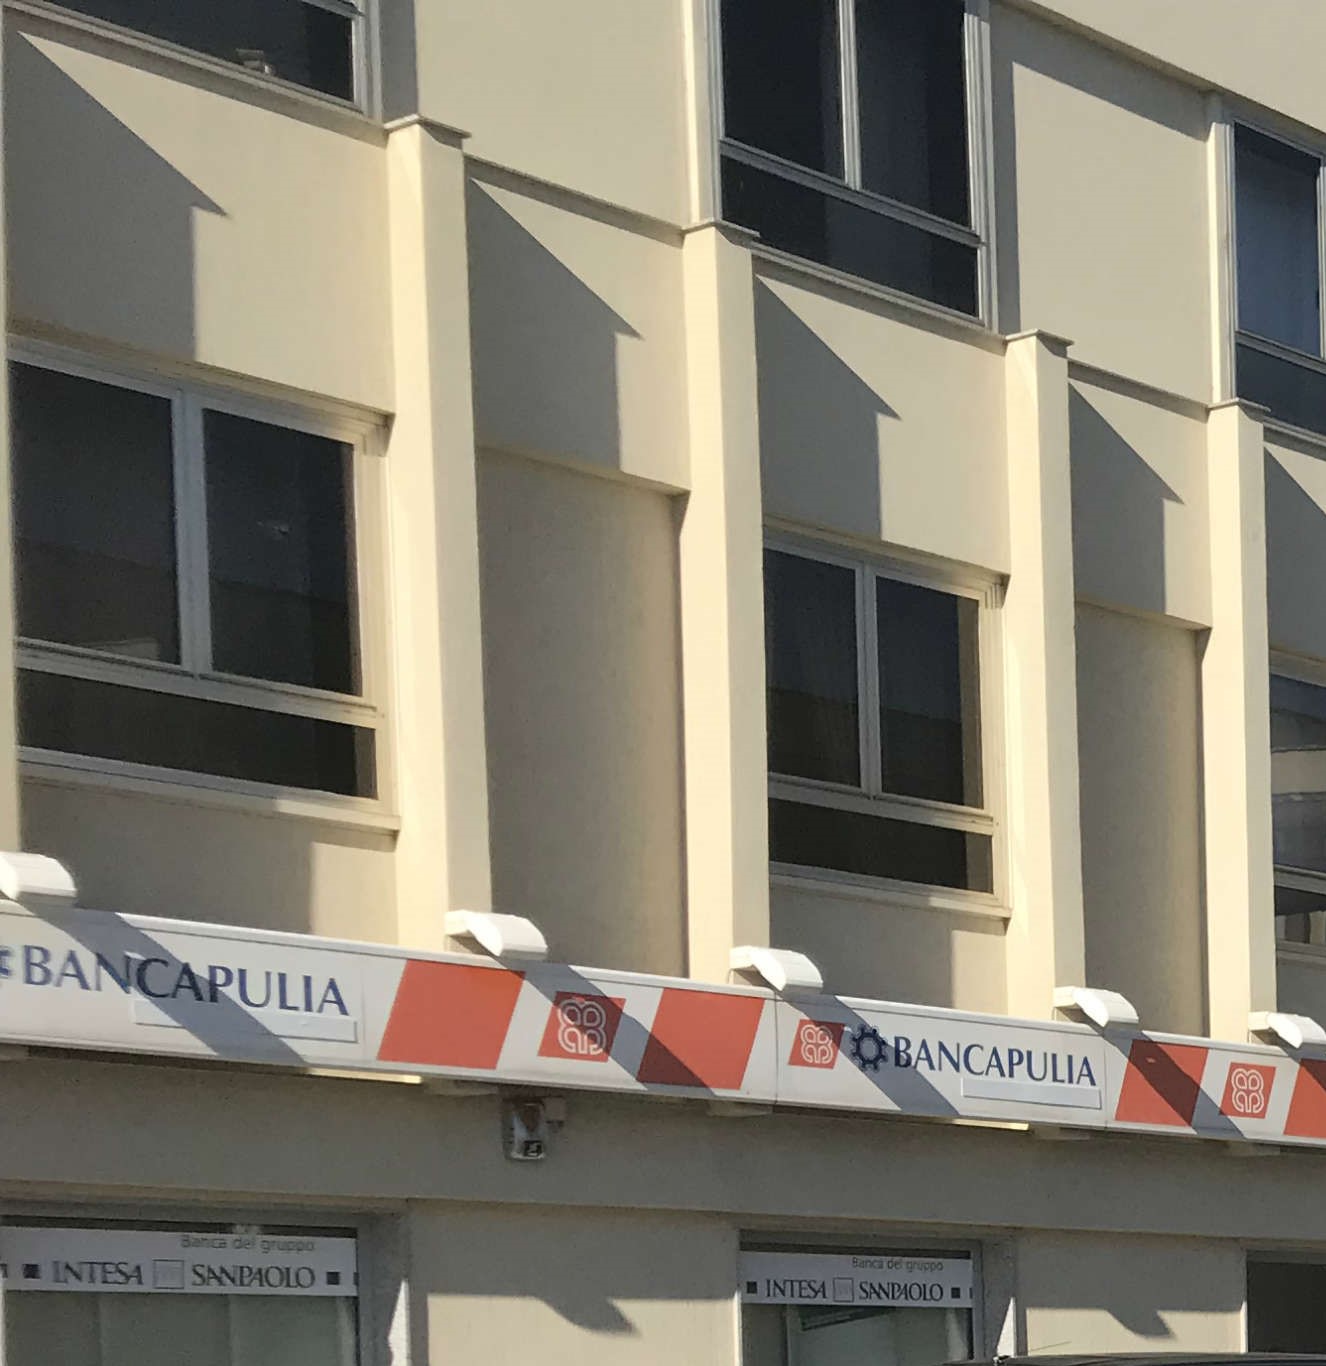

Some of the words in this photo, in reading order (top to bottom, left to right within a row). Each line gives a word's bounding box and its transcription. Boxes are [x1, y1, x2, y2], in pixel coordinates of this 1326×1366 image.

[23, 945, 349, 1016] BANCAPULIA
[894, 1036, 1096, 1087] BANCAPULIA
[182, 1234, 227, 1249] Banca
[233, 1236, 256, 1250] del
[261, 1240, 315, 1254] gruppo
[53, 1260, 145, 1285] INTESA
[192, 1264, 316, 1288] SANPAOLO
[852, 1256, 884, 1271] Banca
[887, 1258, 902, 1270] del
[906, 1260, 944, 1273] gruppo
[766, 1279, 827, 1299] INTESA
[859, 1281, 944, 1302] SANPAOLO
